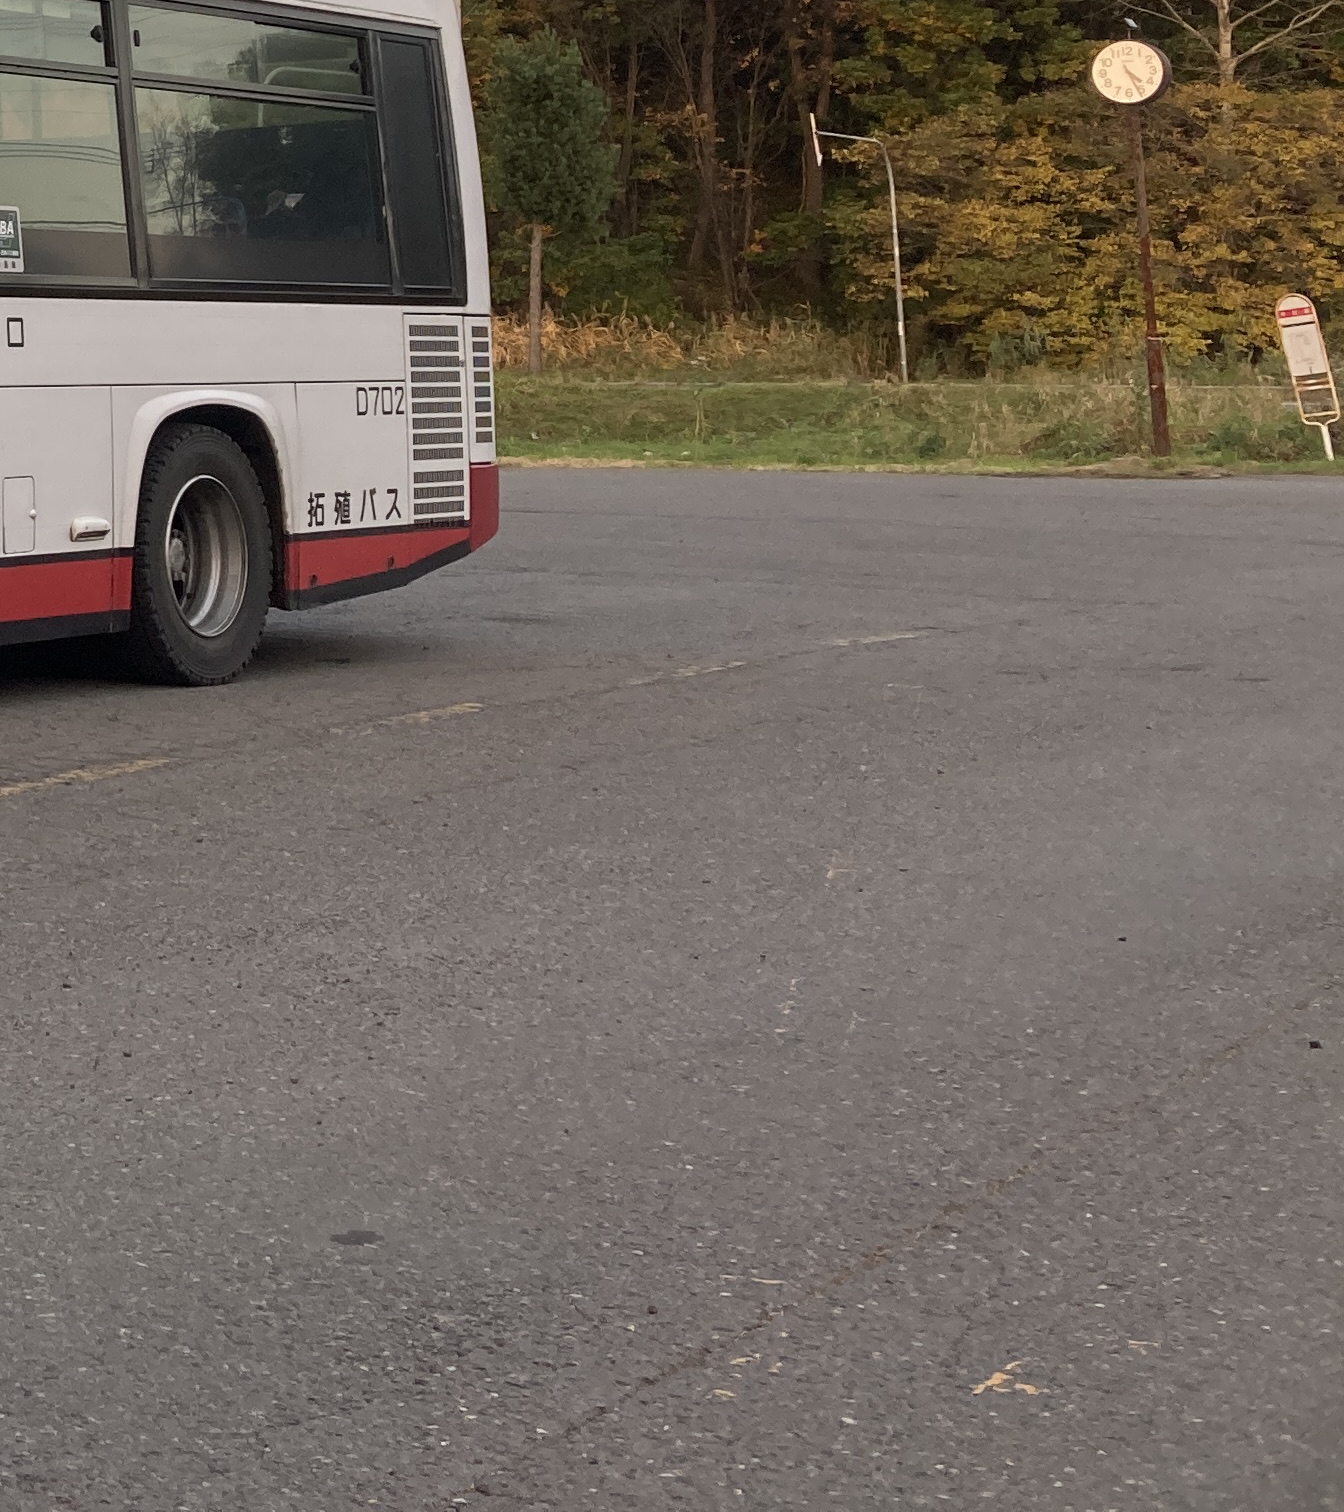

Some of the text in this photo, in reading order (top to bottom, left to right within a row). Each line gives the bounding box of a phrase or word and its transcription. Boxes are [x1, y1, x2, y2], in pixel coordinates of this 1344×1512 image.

[1121, 47, 1132, 55] 12
[1102, 58, 1112, 67] 10
[1145, 55, 1152, 64] 2
[1099, 69, 1107, 78] 9
[1149, 66, 1157, 75] 3
[1104, 78, 1112, 87] 8
[1146, 77, 1154, 85] 4
[1115, 86, 1121, 95] 7
[1125, 88, 1133, 97] 6
[356, 387, 404, 416] D702
[307, 487, 402, 528] 拓殖バス
